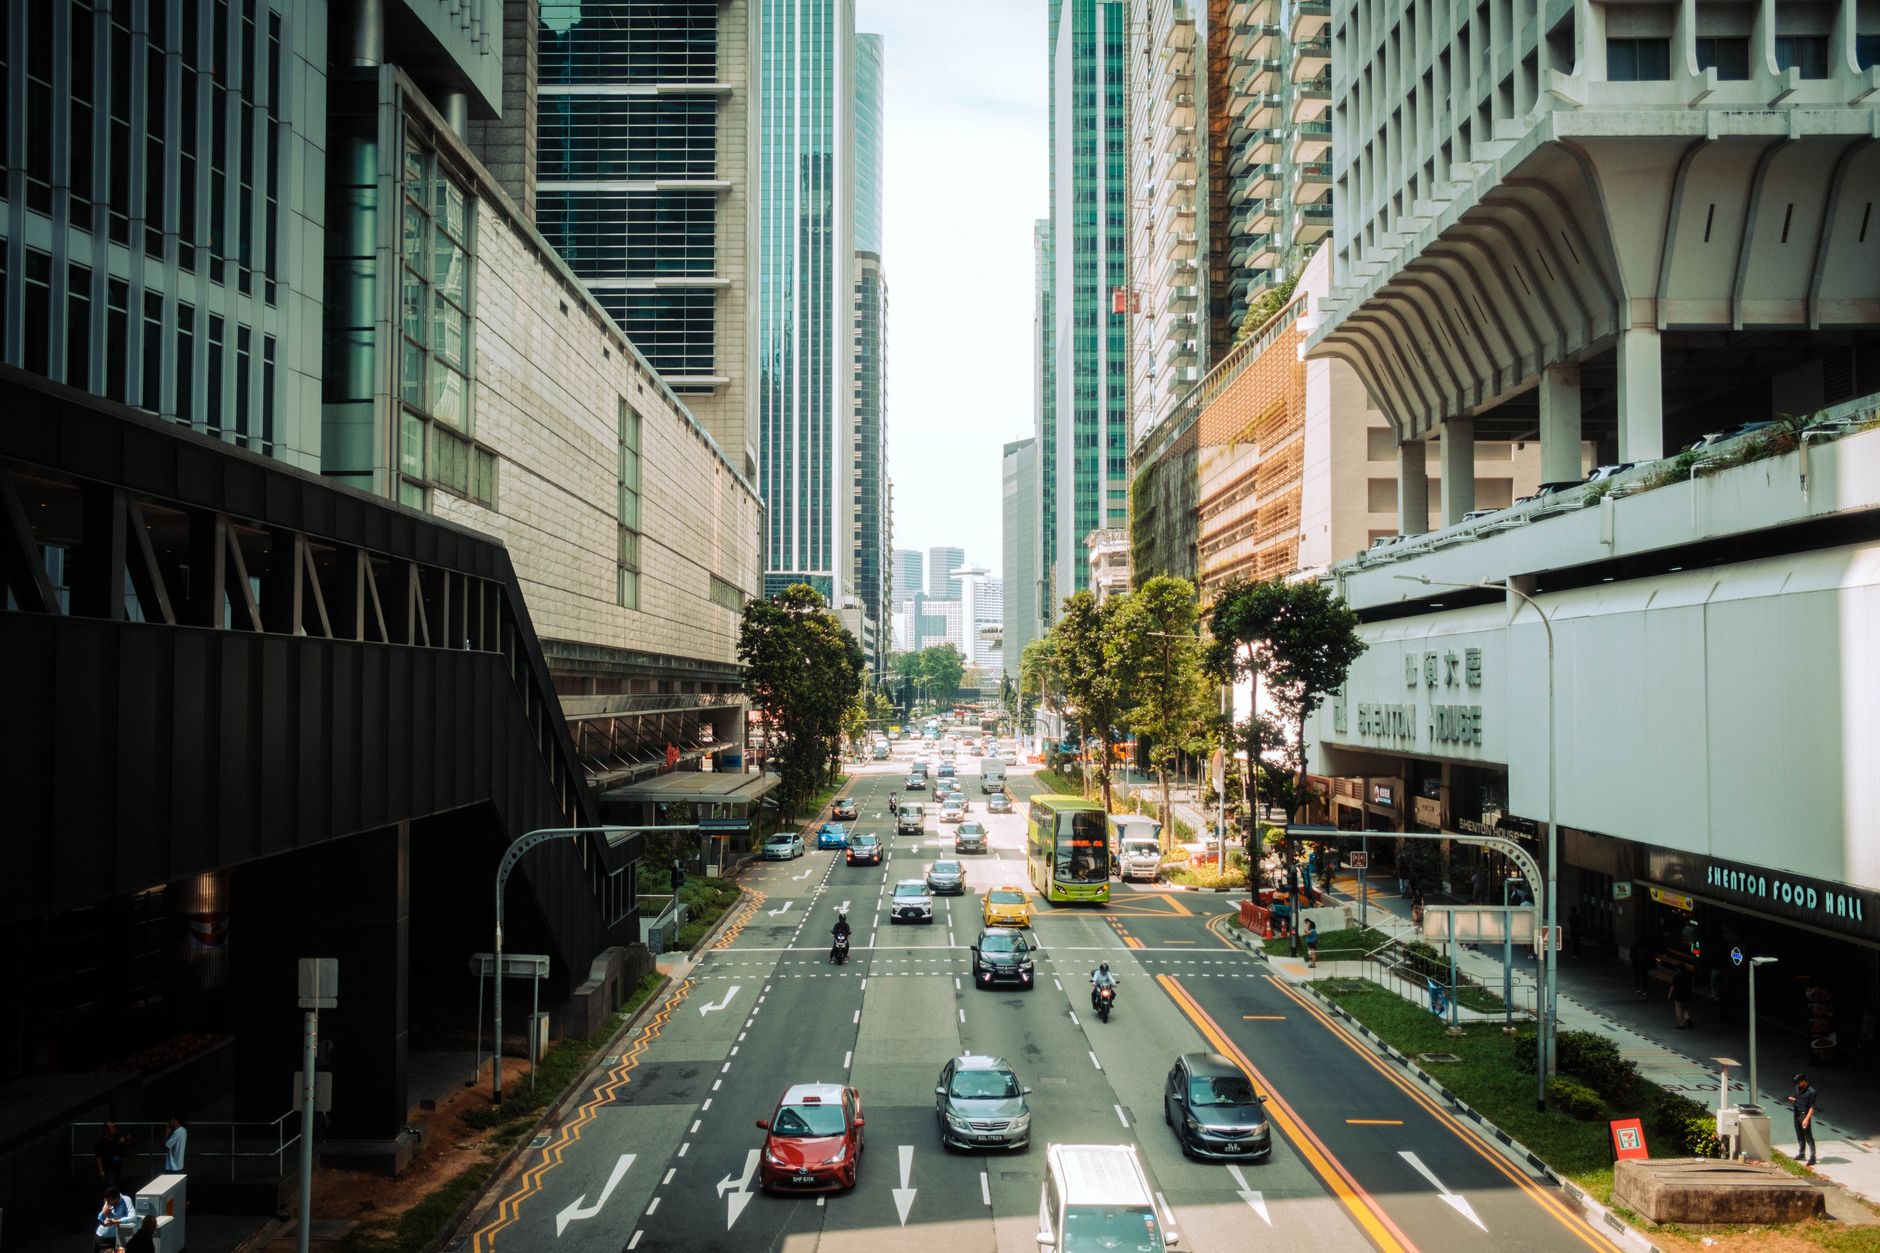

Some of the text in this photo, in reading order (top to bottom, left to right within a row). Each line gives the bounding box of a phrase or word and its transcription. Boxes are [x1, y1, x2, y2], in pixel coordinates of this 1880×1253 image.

[1358, 703, 1416, 740] SHENTON
[1428, 704, 1482, 746] HOUSE
[1459, 817, 1492, 836] SHENTON
[1493, 826, 1520, 843] HOUSE
[1707, 865, 1766, 898] SHENTON
[1773, 879, 1818, 910] FOOD
[1825, 890, 1863, 922] HALL
